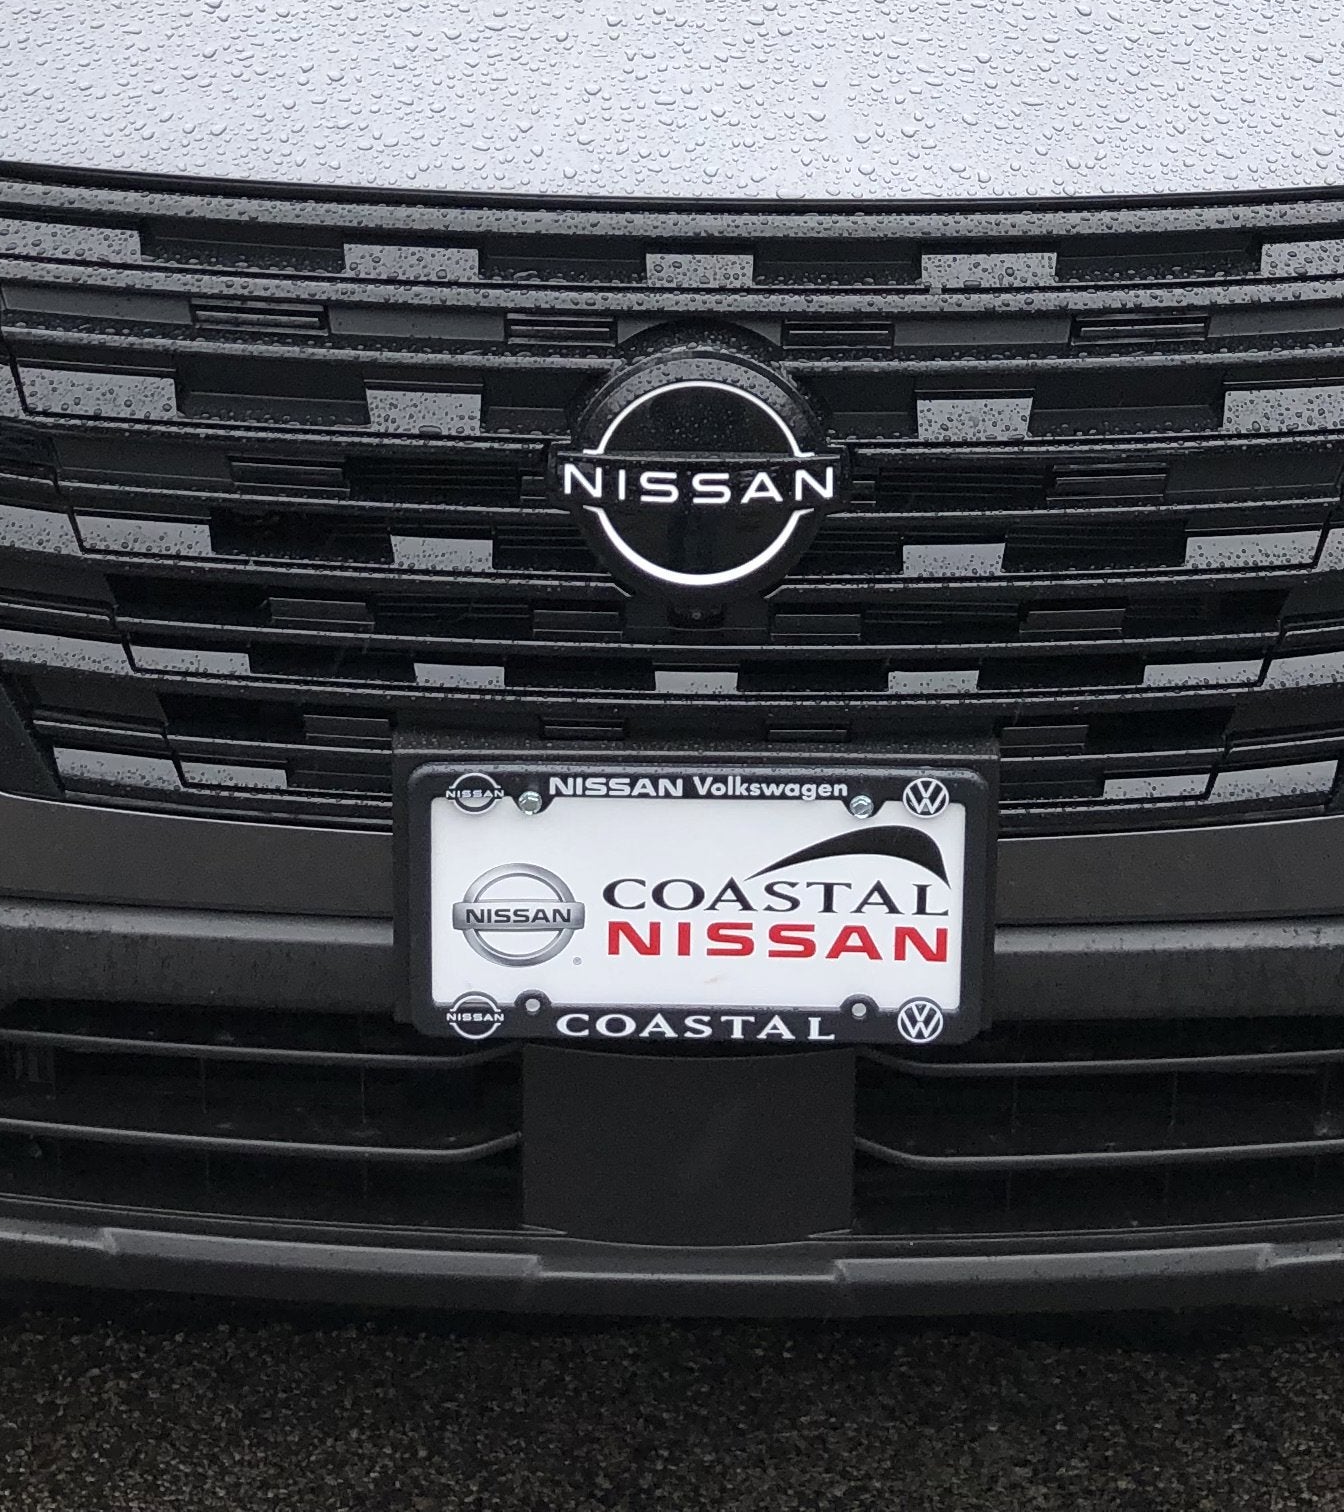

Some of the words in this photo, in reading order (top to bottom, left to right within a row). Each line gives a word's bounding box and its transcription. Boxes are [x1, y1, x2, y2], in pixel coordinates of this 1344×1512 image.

[563, 463, 834, 504] NISSAN
[445, 789, 505, 799] NISSAN
[549, 776, 683, 797] NISSAN
[692, 775, 848, 801] Volkswagen
[602, 876, 949, 916] COASTAL
[465, 908, 572, 925] NISSAN
[607, 921, 948, 963] NISSAN
[446, 1012, 505, 1022] NISSAN
[556, 1012, 836, 1040] COASTAL
